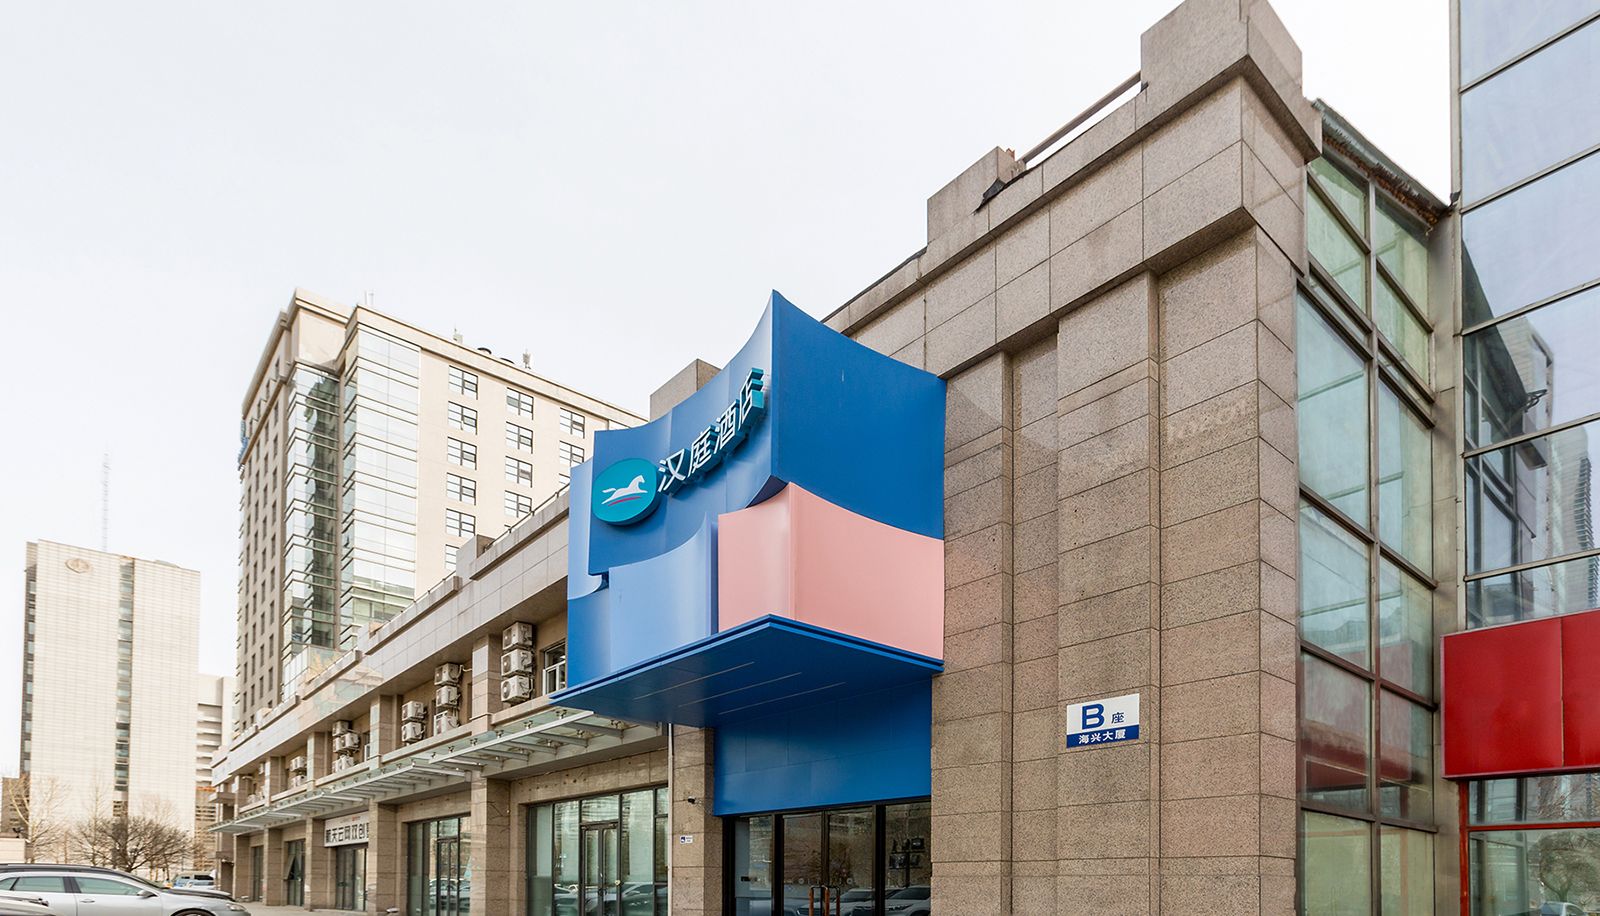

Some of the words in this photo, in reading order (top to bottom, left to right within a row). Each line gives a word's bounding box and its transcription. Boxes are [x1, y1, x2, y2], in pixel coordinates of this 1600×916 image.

[657, 367, 764, 493] 汉庭酒店
[1078, 728, 1126, 744] 海兴大厦
